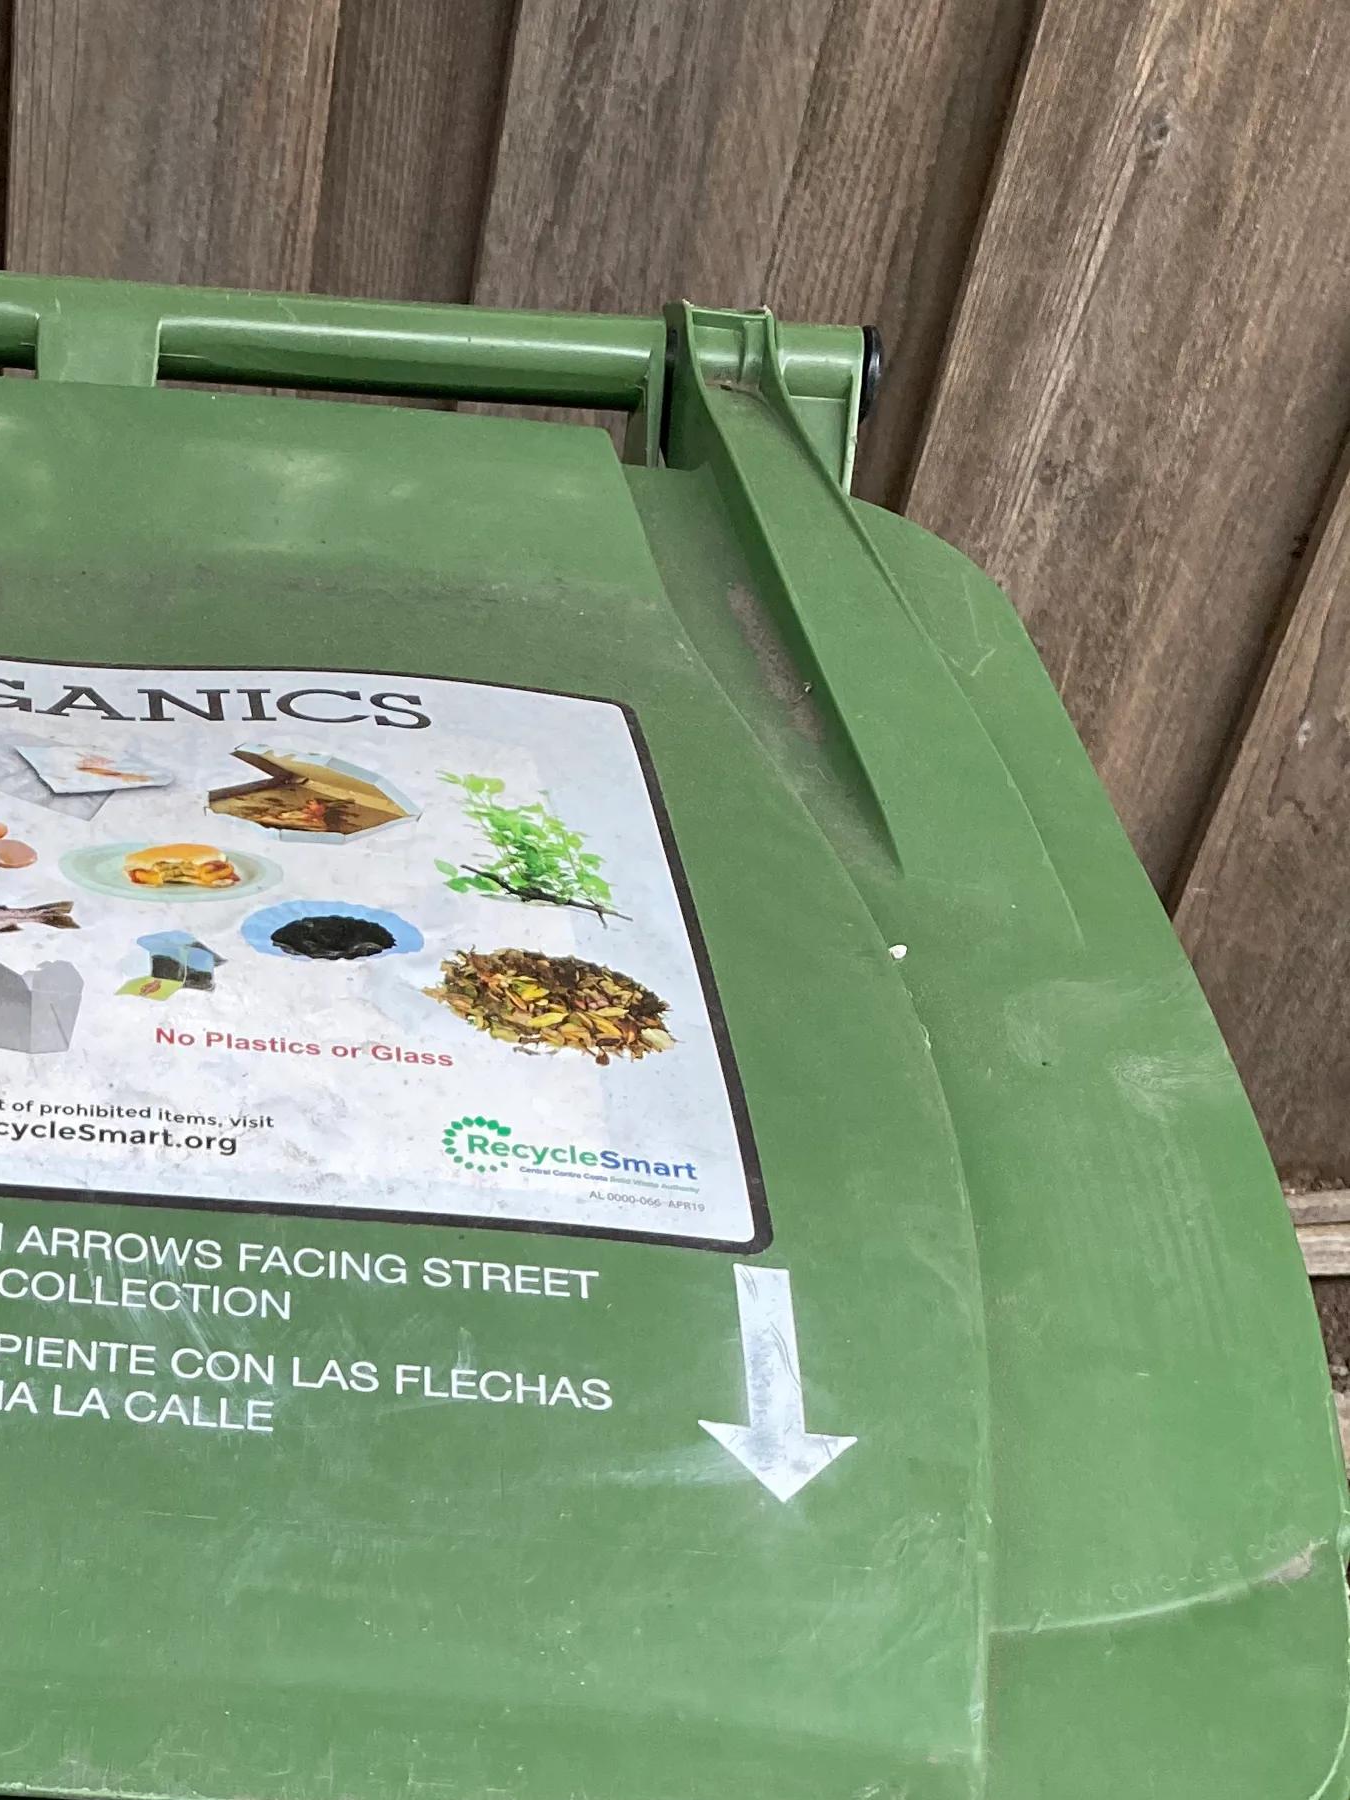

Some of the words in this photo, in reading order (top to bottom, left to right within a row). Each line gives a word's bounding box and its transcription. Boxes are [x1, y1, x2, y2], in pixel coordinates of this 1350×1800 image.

[155, 1028, 195, 1046] No
[206, 1031, 321, 1056] Plastics
[331, 1045, 362, 1059] or
[371, 1045, 454, 1067] Glass
[12, 1099, 35, 1114] of
[40, 1103, 151, 1121] prohibited
[158, 1108, 224, 1128] items,
[230, 1115, 275, 1130] visit
[467, 1134, 698, 1181] RecycleSmart
[16, 1225, 222, 1270] ARROWS
[238, 1244, 408, 1285] FACING
[422, 1257, 599, 1299] STREET
[170, 1347, 275, 1385] CON
[292, 1357, 379, 1393] LAS
[395, 1365, 613, 1412] FLECHAS
[52, 1384, 110, 1421] LA
[124, 1390, 275, 1432] CALLE
